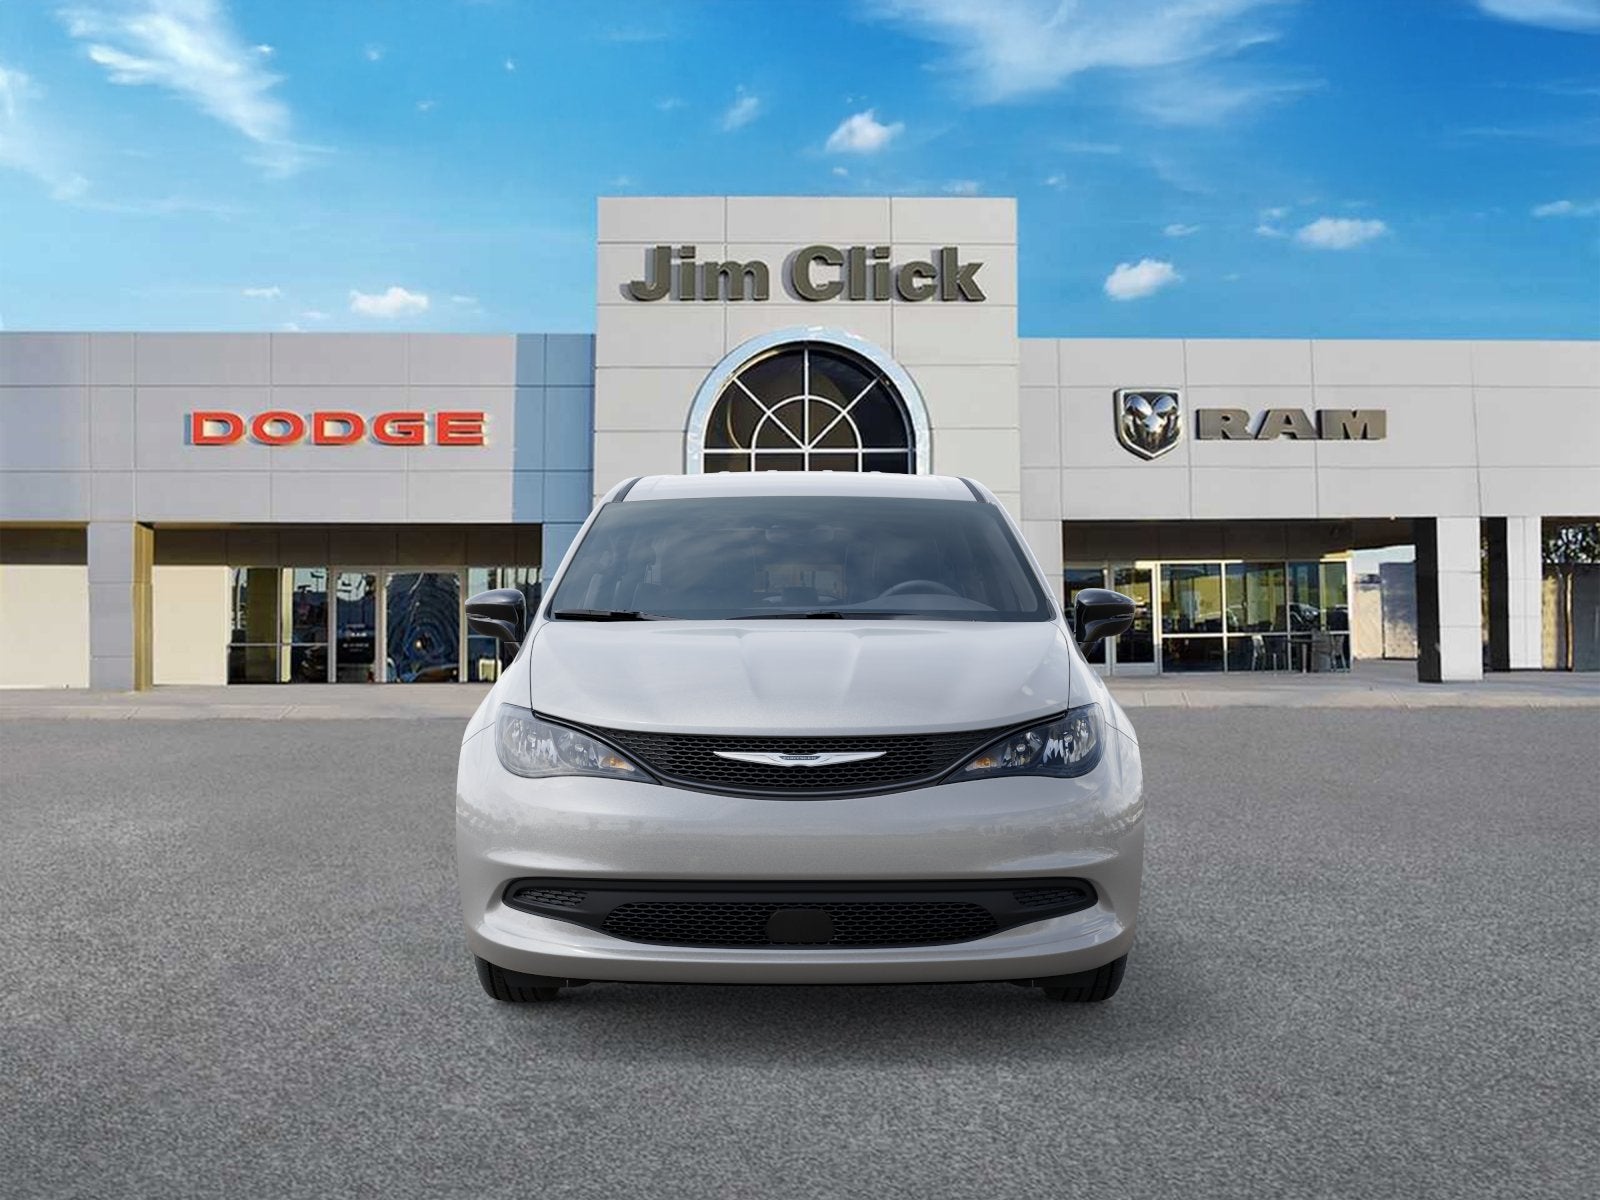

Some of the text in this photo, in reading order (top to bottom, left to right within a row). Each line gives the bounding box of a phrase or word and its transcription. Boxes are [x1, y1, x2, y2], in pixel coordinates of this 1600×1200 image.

[627, 245, 986, 302] Jim Click
[190, 411, 486, 446] DODGE
[1195, 408, 1387, 440] RAM
